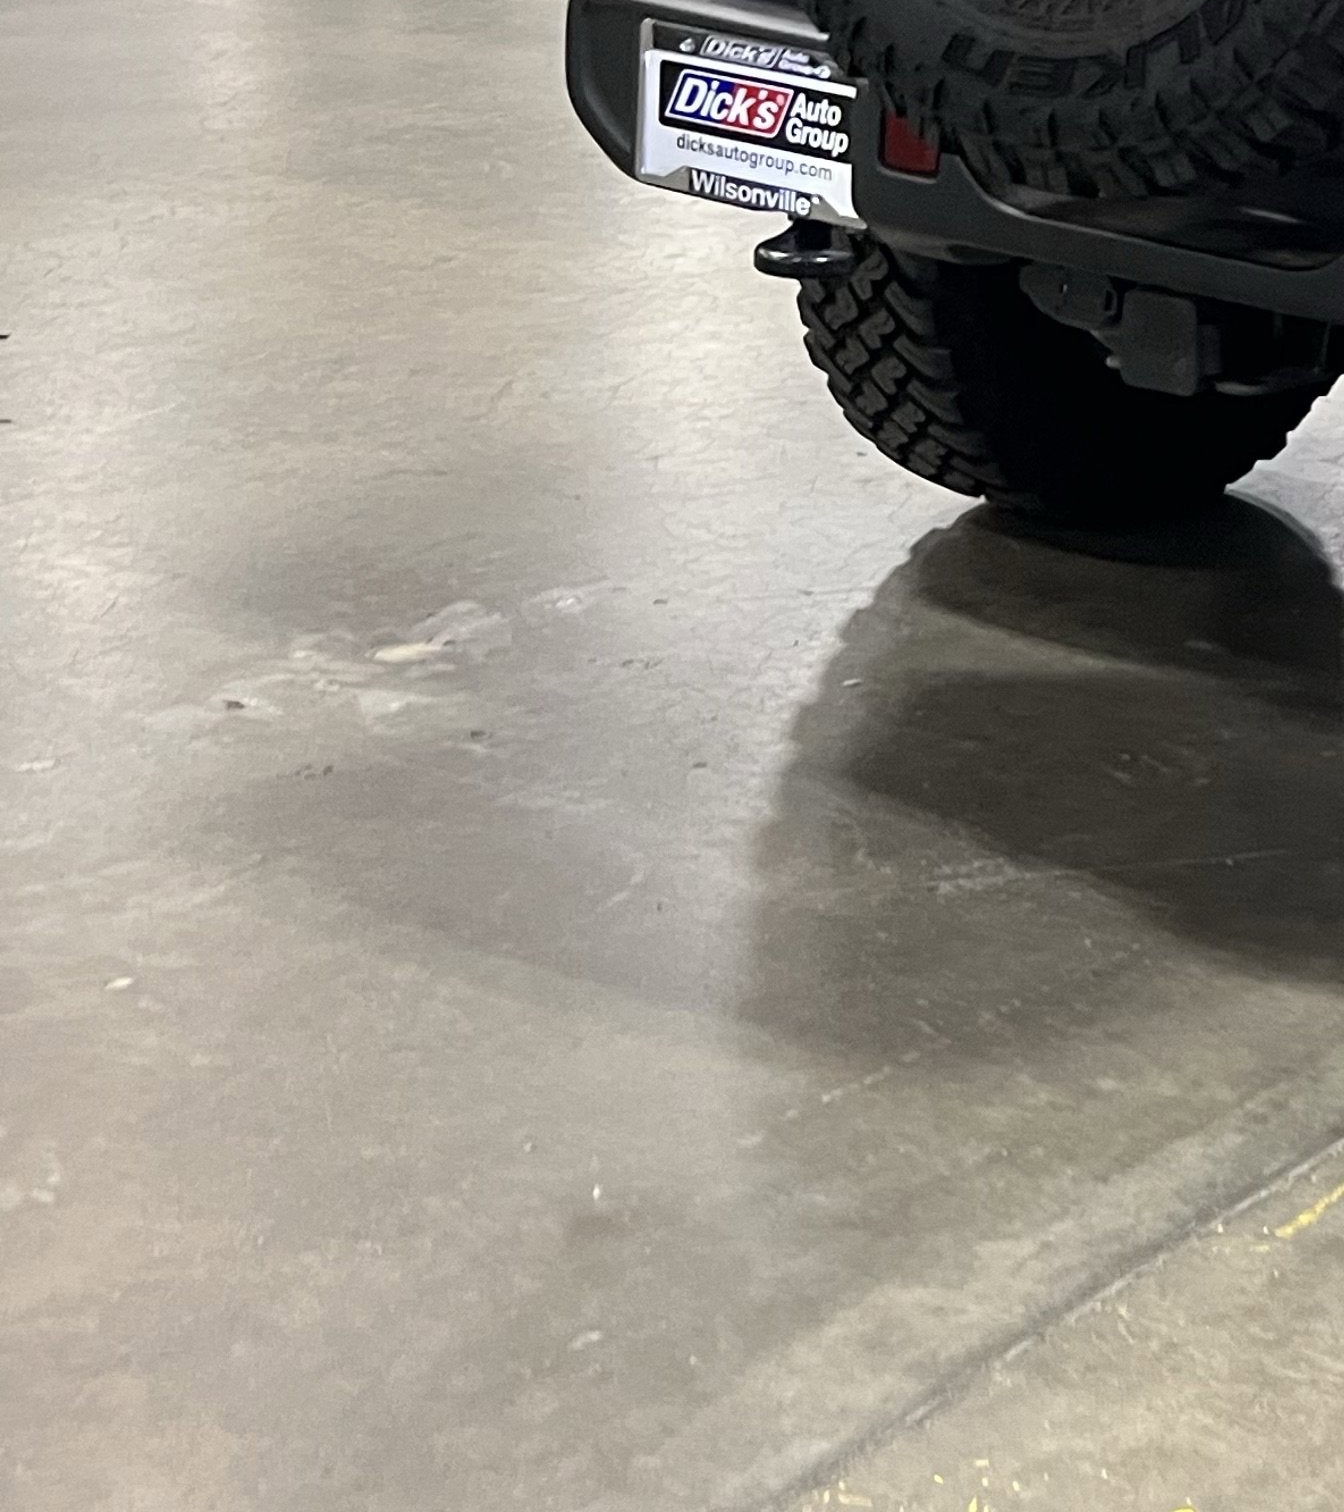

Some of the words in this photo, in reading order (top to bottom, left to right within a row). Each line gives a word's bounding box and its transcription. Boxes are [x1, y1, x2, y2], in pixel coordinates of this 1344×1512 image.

[674, 77, 780, 129] Dick's
[791, 93, 842, 127] Auto
[676, 133, 833, 181] dicksautogroup.com
[785, 118, 849, 157] Group
[691, 169, 812, 217] Wilsonville
